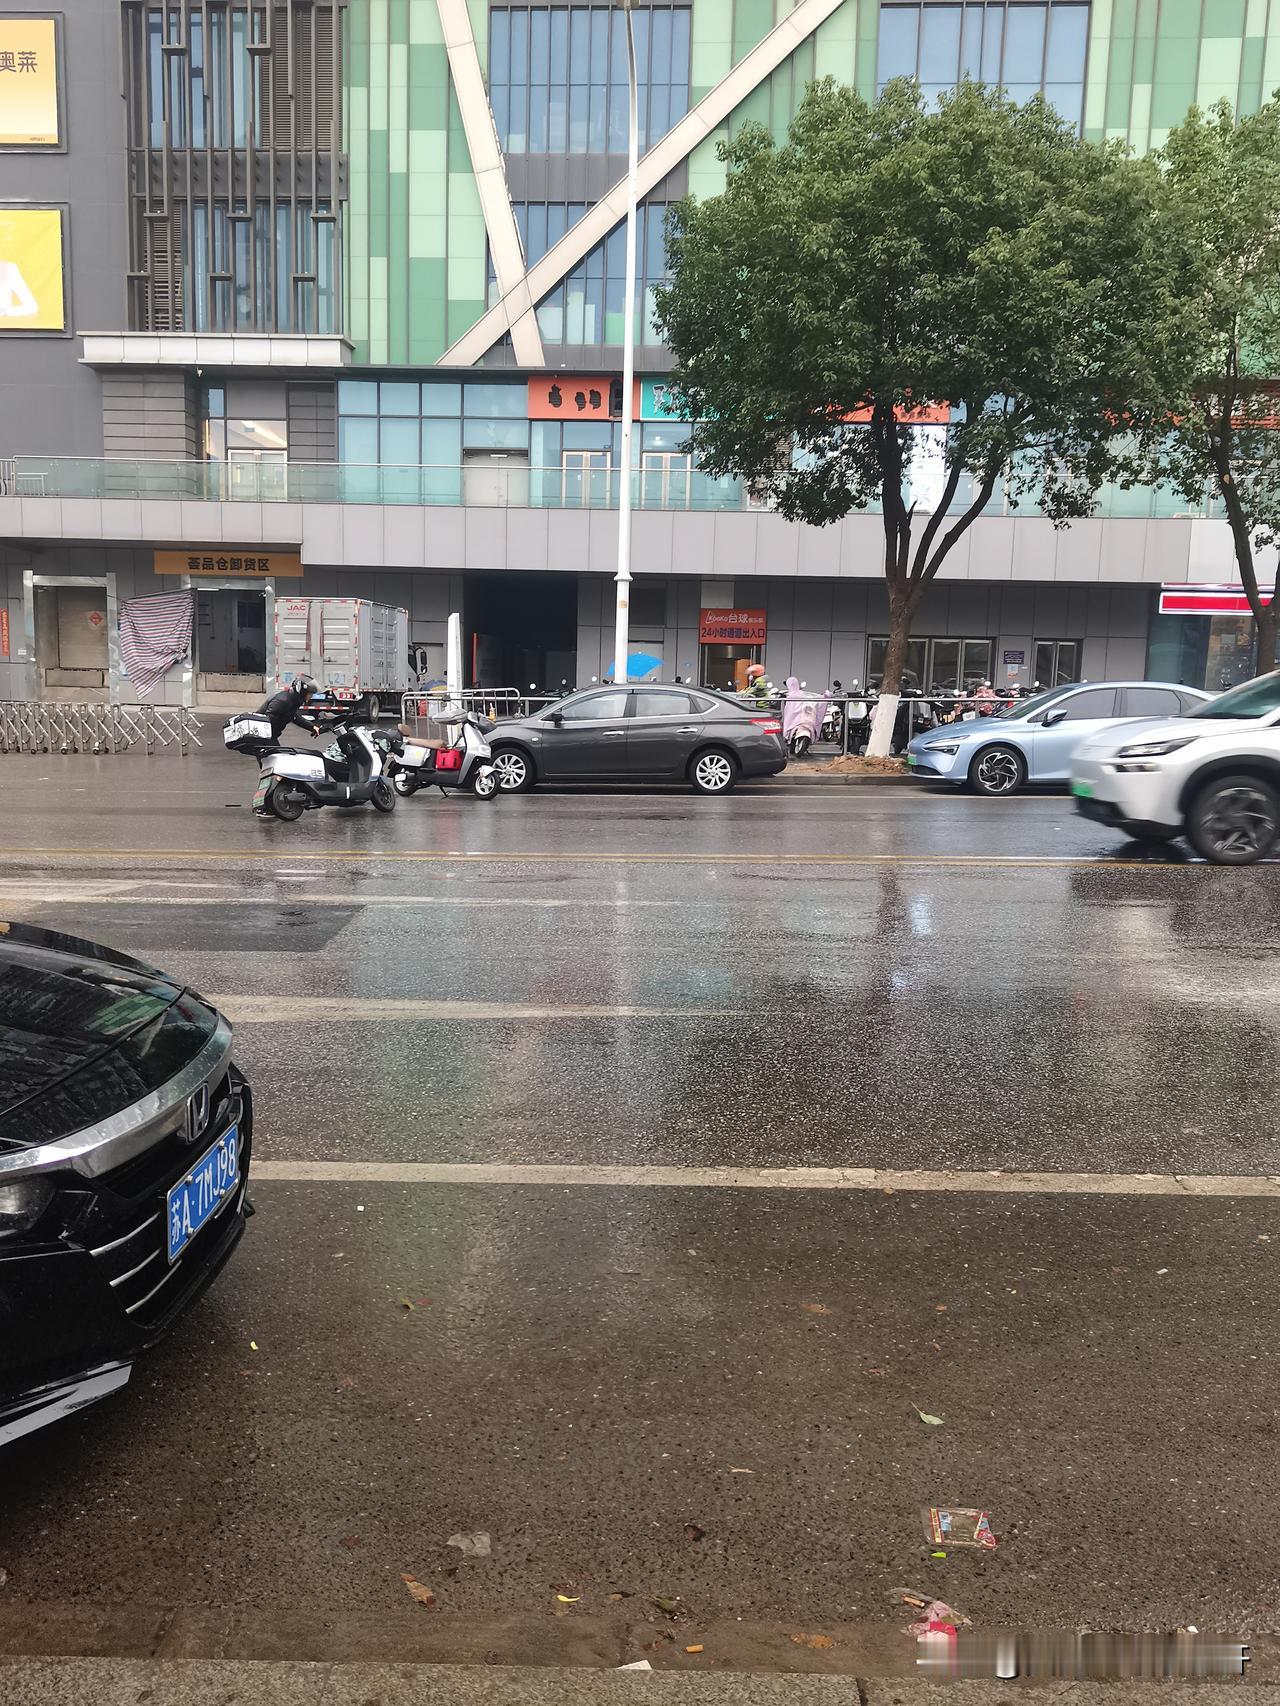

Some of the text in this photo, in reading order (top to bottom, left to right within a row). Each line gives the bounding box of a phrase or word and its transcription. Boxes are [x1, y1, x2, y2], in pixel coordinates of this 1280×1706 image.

[0, 50, 38, 73] 奥莱
[187, 556, 271, 572] 荟品仓卸货区
